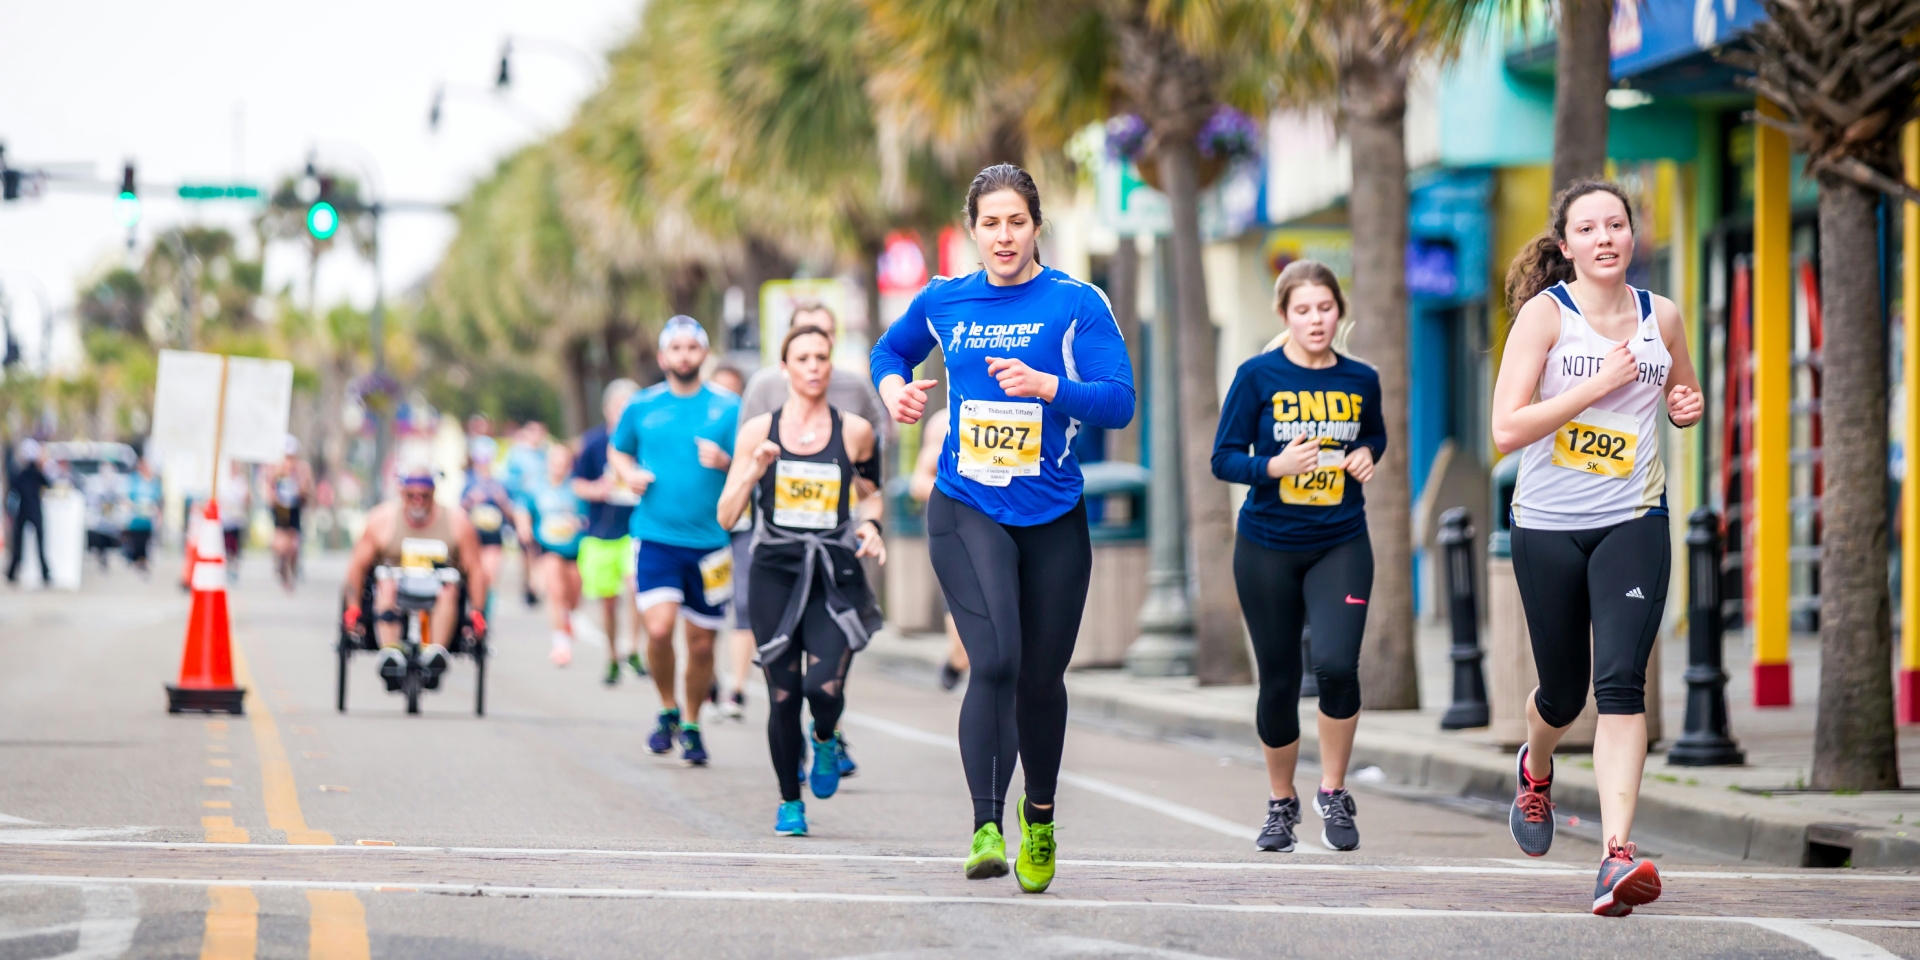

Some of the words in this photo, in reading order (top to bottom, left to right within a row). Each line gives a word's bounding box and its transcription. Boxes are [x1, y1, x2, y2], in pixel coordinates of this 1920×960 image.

[968, 321, 983, 336] le
[984, 322, 1045, 336] coureur
[964, 334, 1031, 352] nordique
[1562, 355, 1604, 378] NOT
[1635, 362, 1666, 387] AME
[1015, 408, 1034, 416] Tiffany
[970, 424, 1031, 451] 1027
[1272, 420, 1317, 442] CROSS
[1567, 427, 1627, 461] 1292
[992, 455, 1005, 465] 5K
[1586, 461, 1599, 471] 5K
[790, 480, 824, 499] 567
[1293, 470, 1338, 491] 1297
